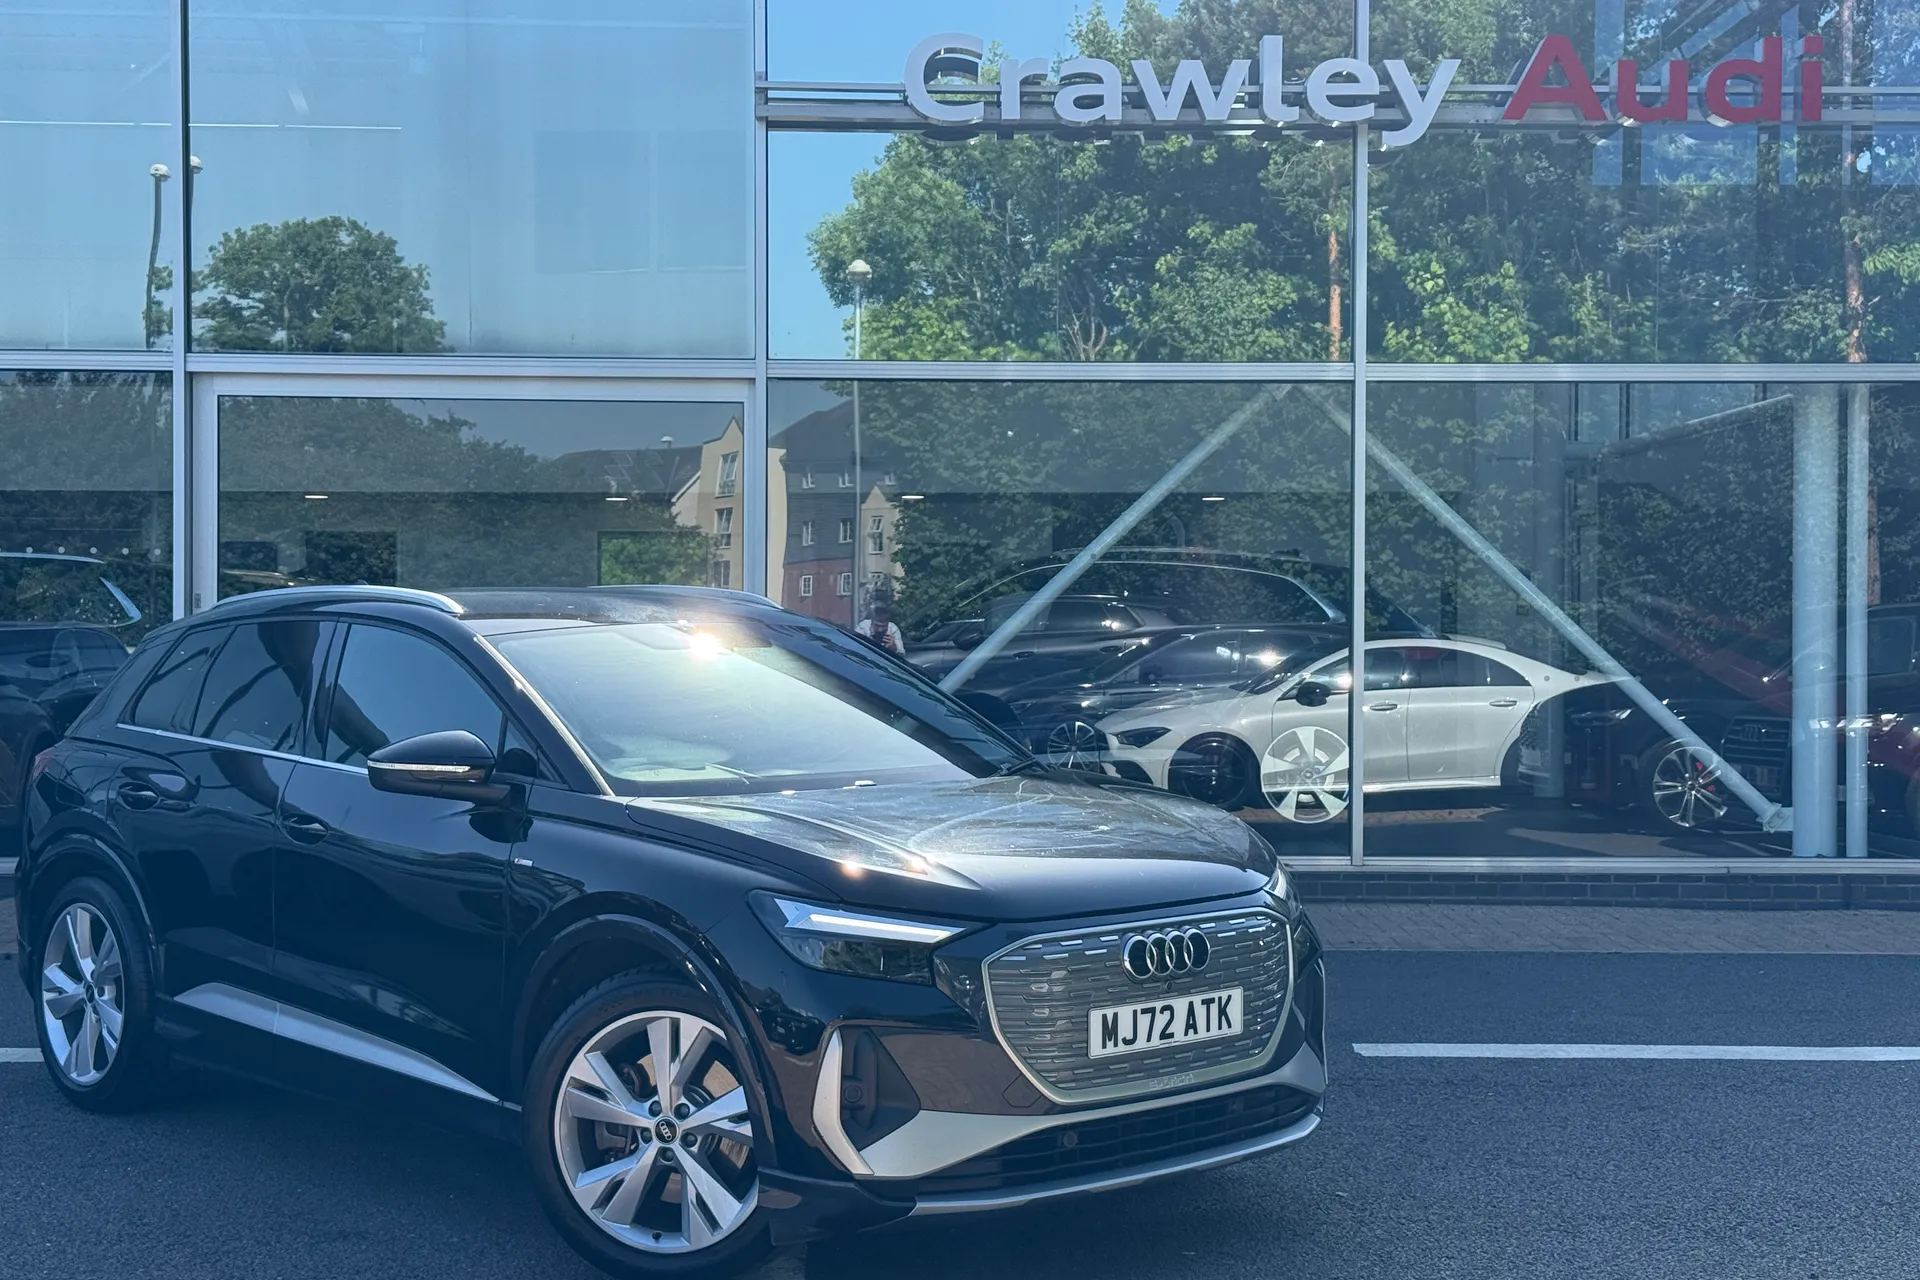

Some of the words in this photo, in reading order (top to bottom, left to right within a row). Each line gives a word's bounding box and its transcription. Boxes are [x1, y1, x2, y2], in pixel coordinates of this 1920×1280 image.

[903, 31, 1463, 147] Crawley
[1501, 34, 1824, 124] Audi
[1101, 1004, 1175, 1050] MJ72
[1183, 994, 1233, 1037] ATK
